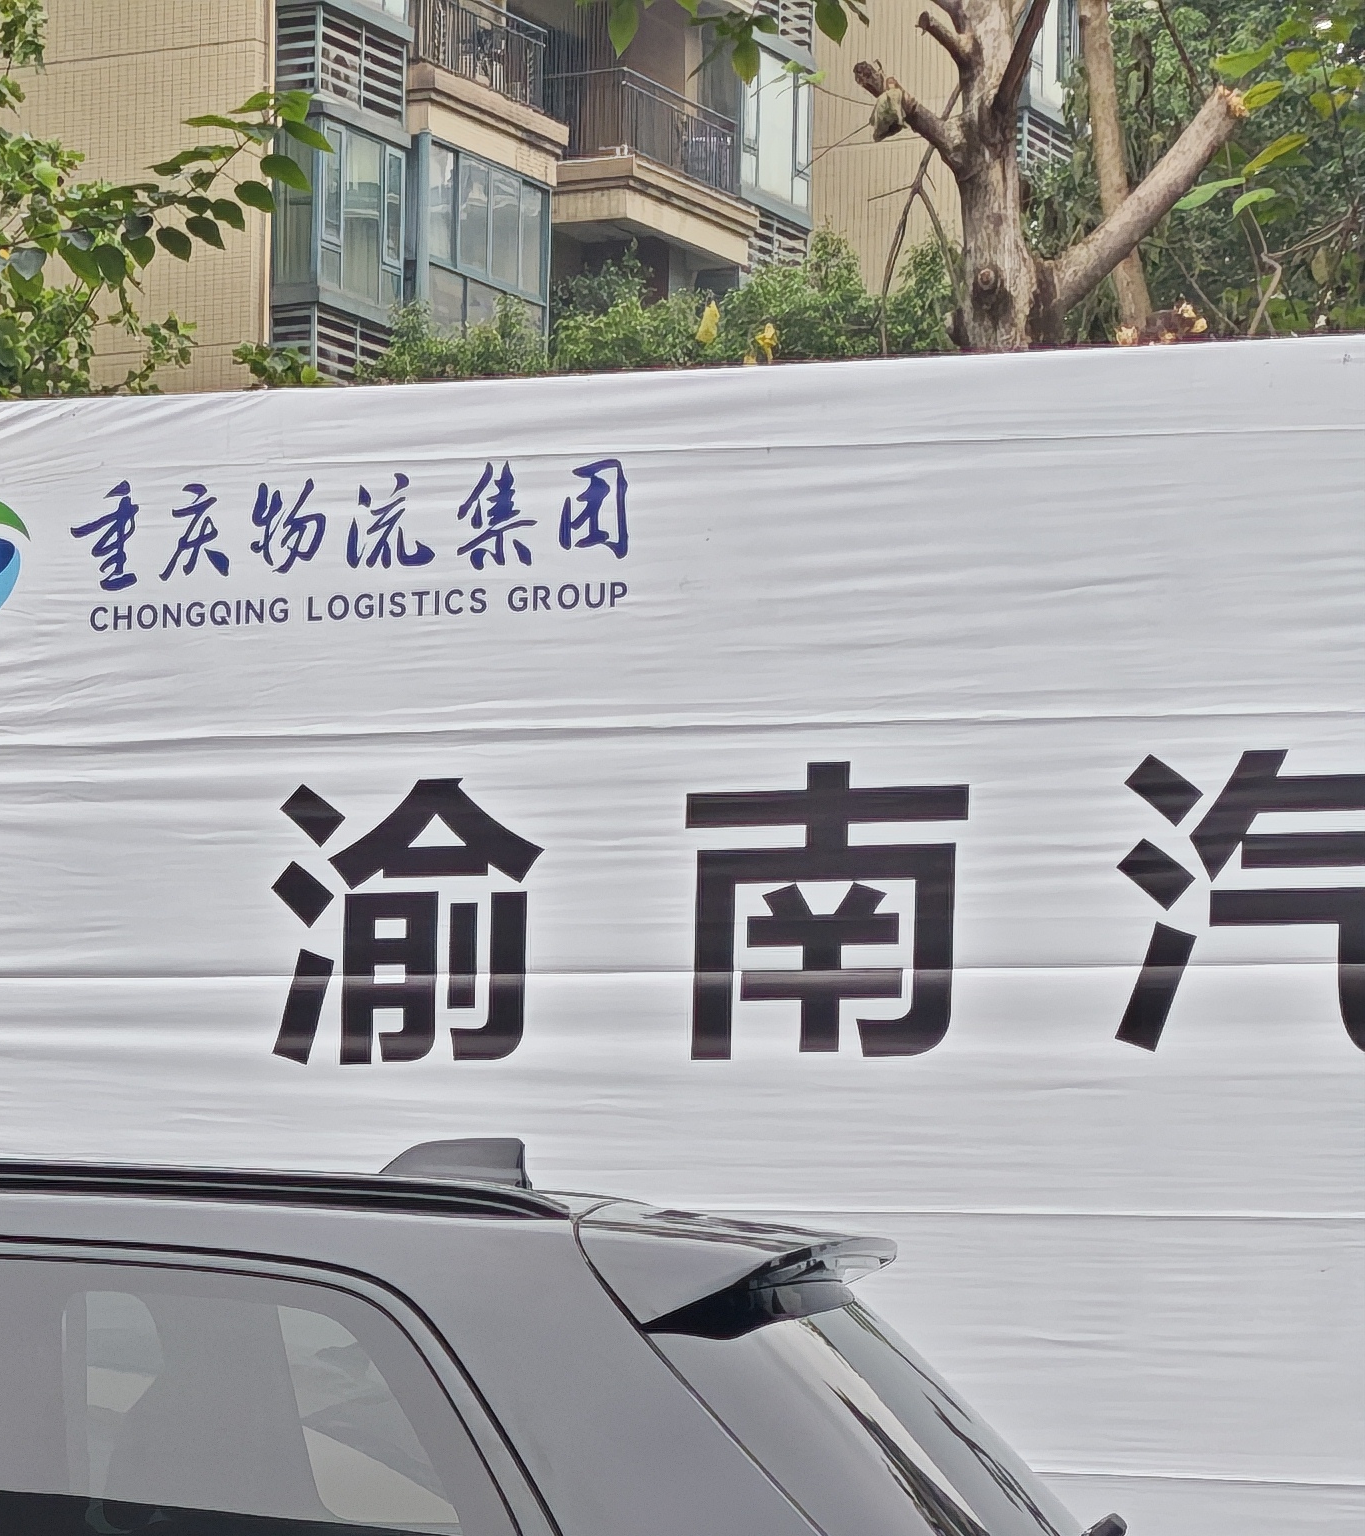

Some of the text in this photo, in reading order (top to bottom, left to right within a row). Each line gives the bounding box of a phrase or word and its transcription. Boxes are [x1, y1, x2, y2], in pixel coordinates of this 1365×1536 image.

[70, 458, 631, 593] 重庆物流集团
[89, 582, 630, 633] CHONGQING LOGISTICS GROUP
[269, 748, 1365, 1066] 渝南汽
